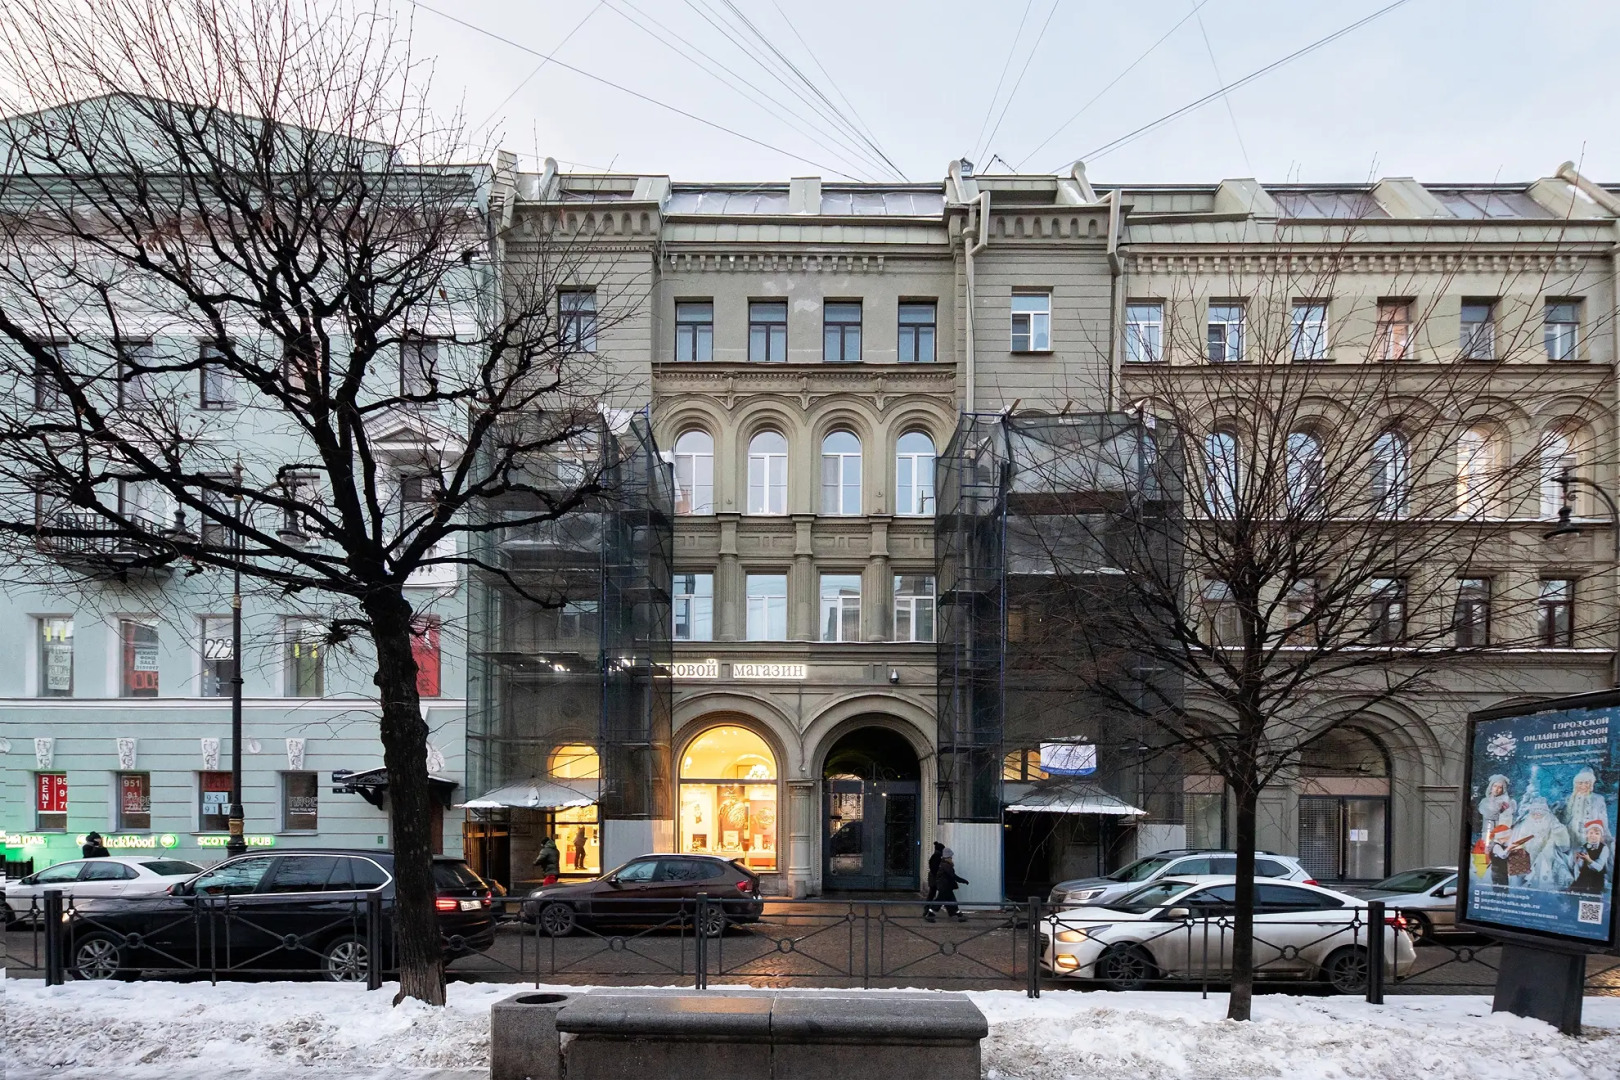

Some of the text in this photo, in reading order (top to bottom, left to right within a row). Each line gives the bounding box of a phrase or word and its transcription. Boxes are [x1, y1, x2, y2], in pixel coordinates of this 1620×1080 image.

[734, 664, 804, 677] магазин
[1553, 717, 1610, 730] ГОРОДСКОЙ
[1523, 727, 1608, 742] ОНЛАЙН-МАРАФОН
[1534, 736, 1608, 750] ПОЗДРАВЛЕНИЙ
[102, 835, 156, 848] lackWood
[251, 836, 273, 846] PUB
